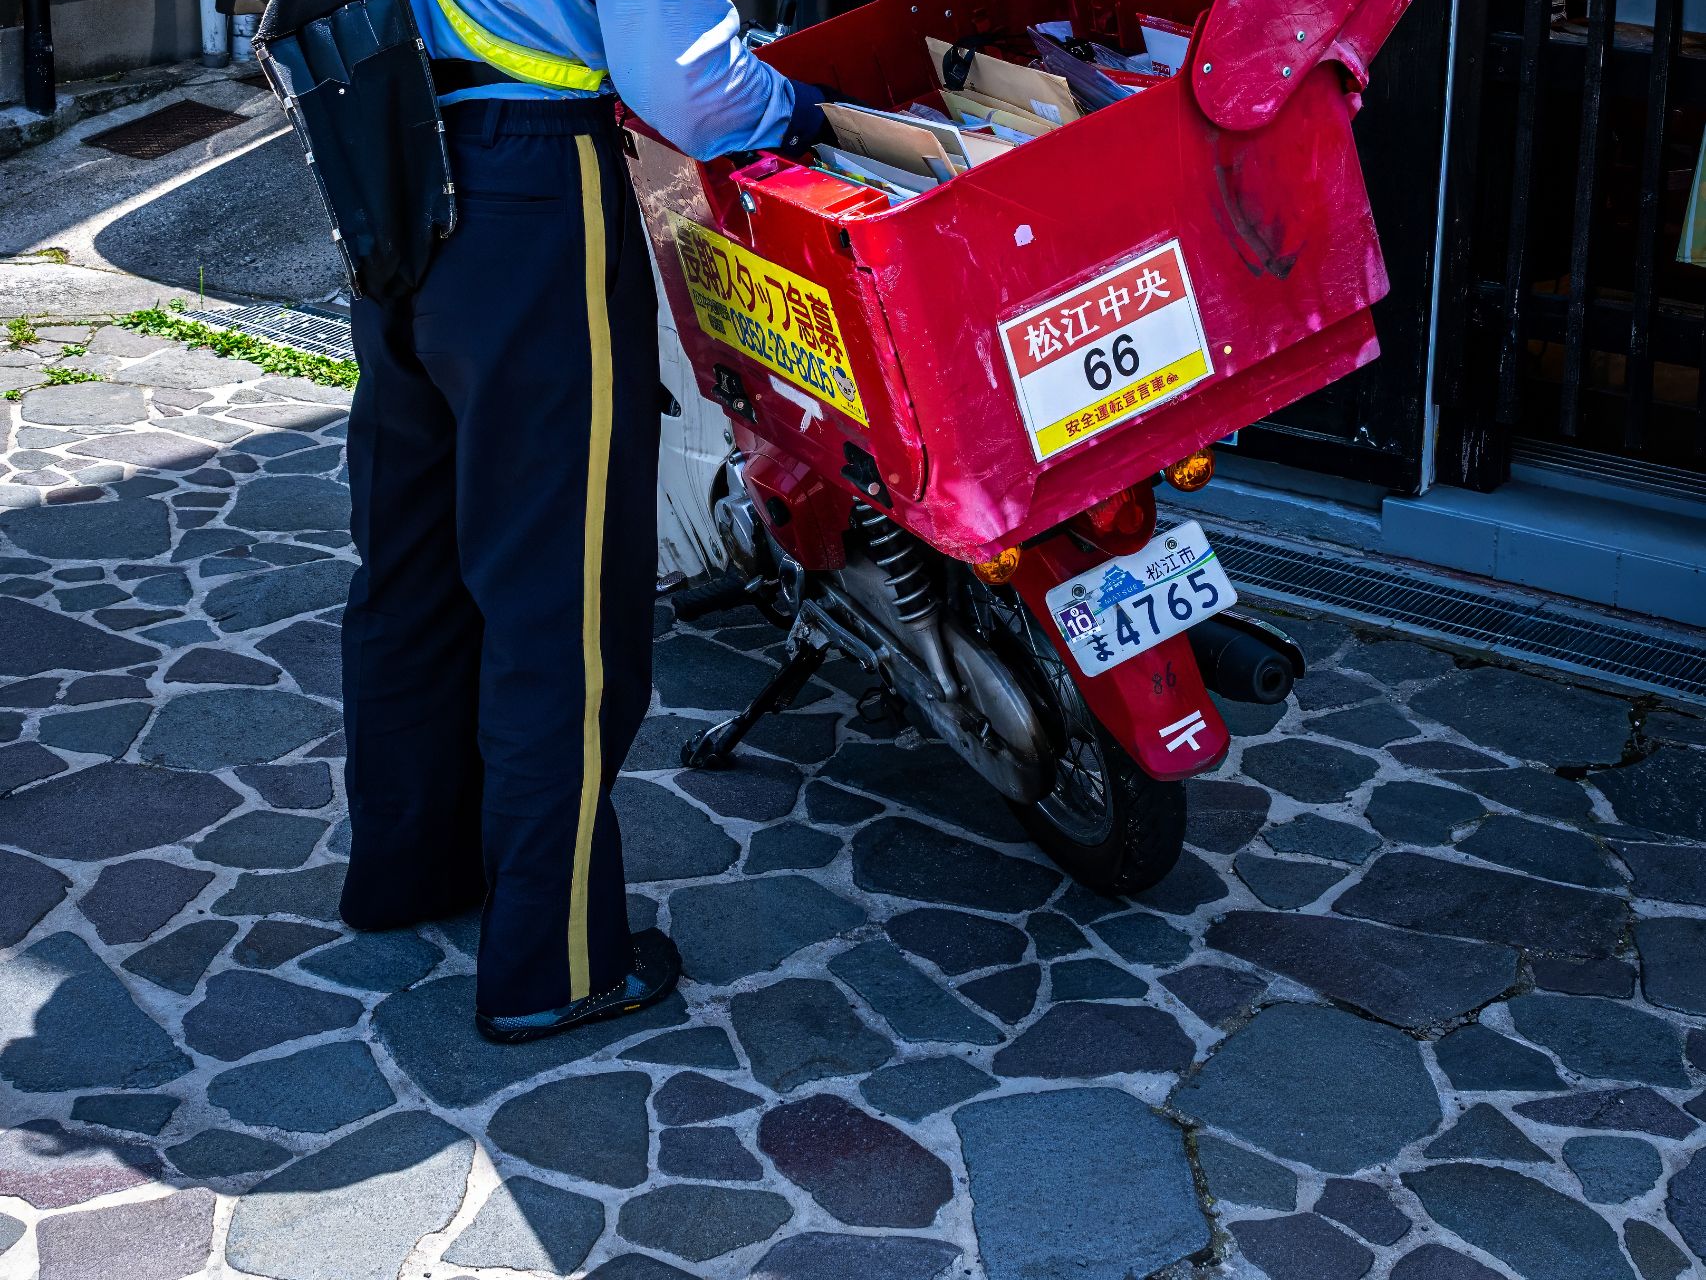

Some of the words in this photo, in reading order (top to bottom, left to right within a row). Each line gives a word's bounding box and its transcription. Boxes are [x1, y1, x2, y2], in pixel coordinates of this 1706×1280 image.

[677, 227, 843, 364] 長期スタッフ急募
[1024, 267, 1170, 362] 松江中央
[730, 309, 835, 398] 0852-28-8205
[1084, 334, 1140, 391] 66
[1065, 375, 1165, 438] 安全運転宣言車
[1146, 546, 1196, 582] 松江市
[1067, 614, 1092, 635] 10
[1087, 634, 1114, 661] ま
[1116, 569, 1219, 646] 4765
